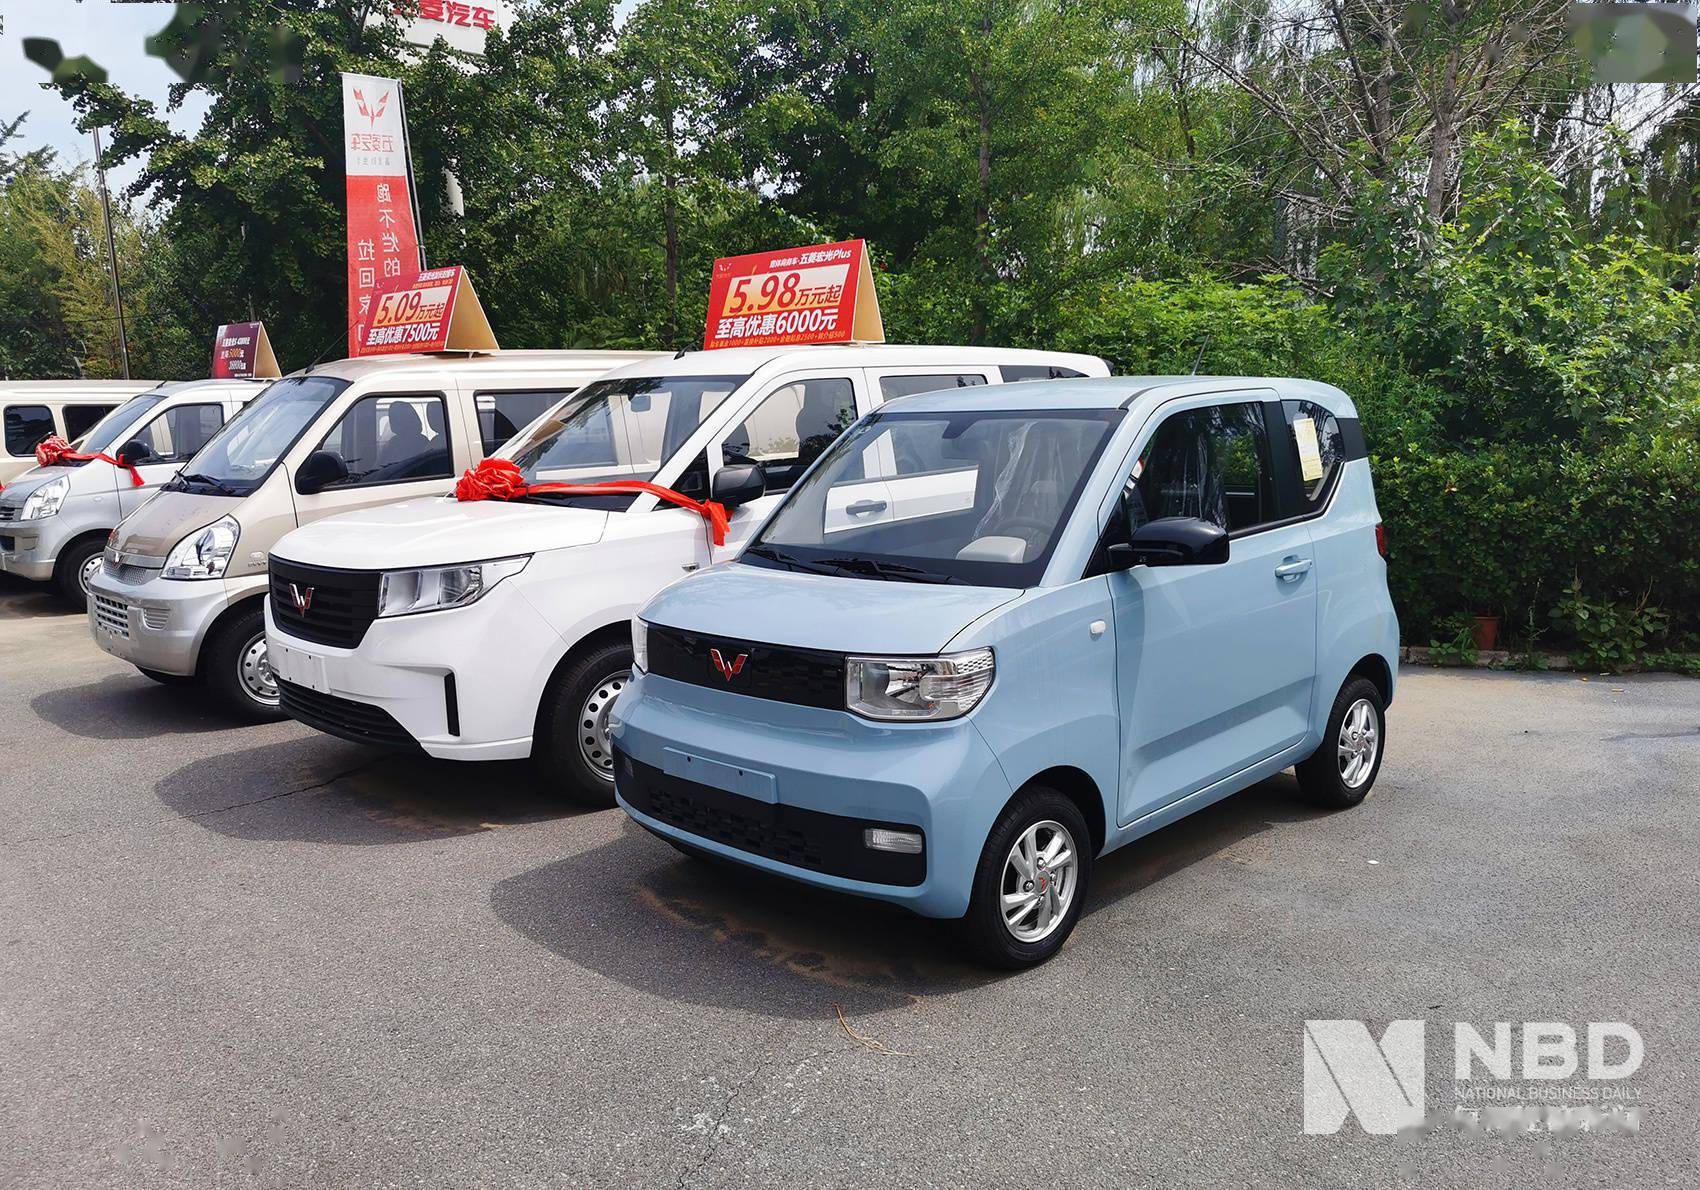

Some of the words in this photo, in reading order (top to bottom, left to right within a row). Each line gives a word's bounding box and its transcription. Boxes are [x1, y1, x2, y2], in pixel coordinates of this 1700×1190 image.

[393, 0, 495, 30] 菱汽车
[366, 322, 441, 346] 至高优惠7500元
[714, 308, 839, 339] 至高优惠6000元
